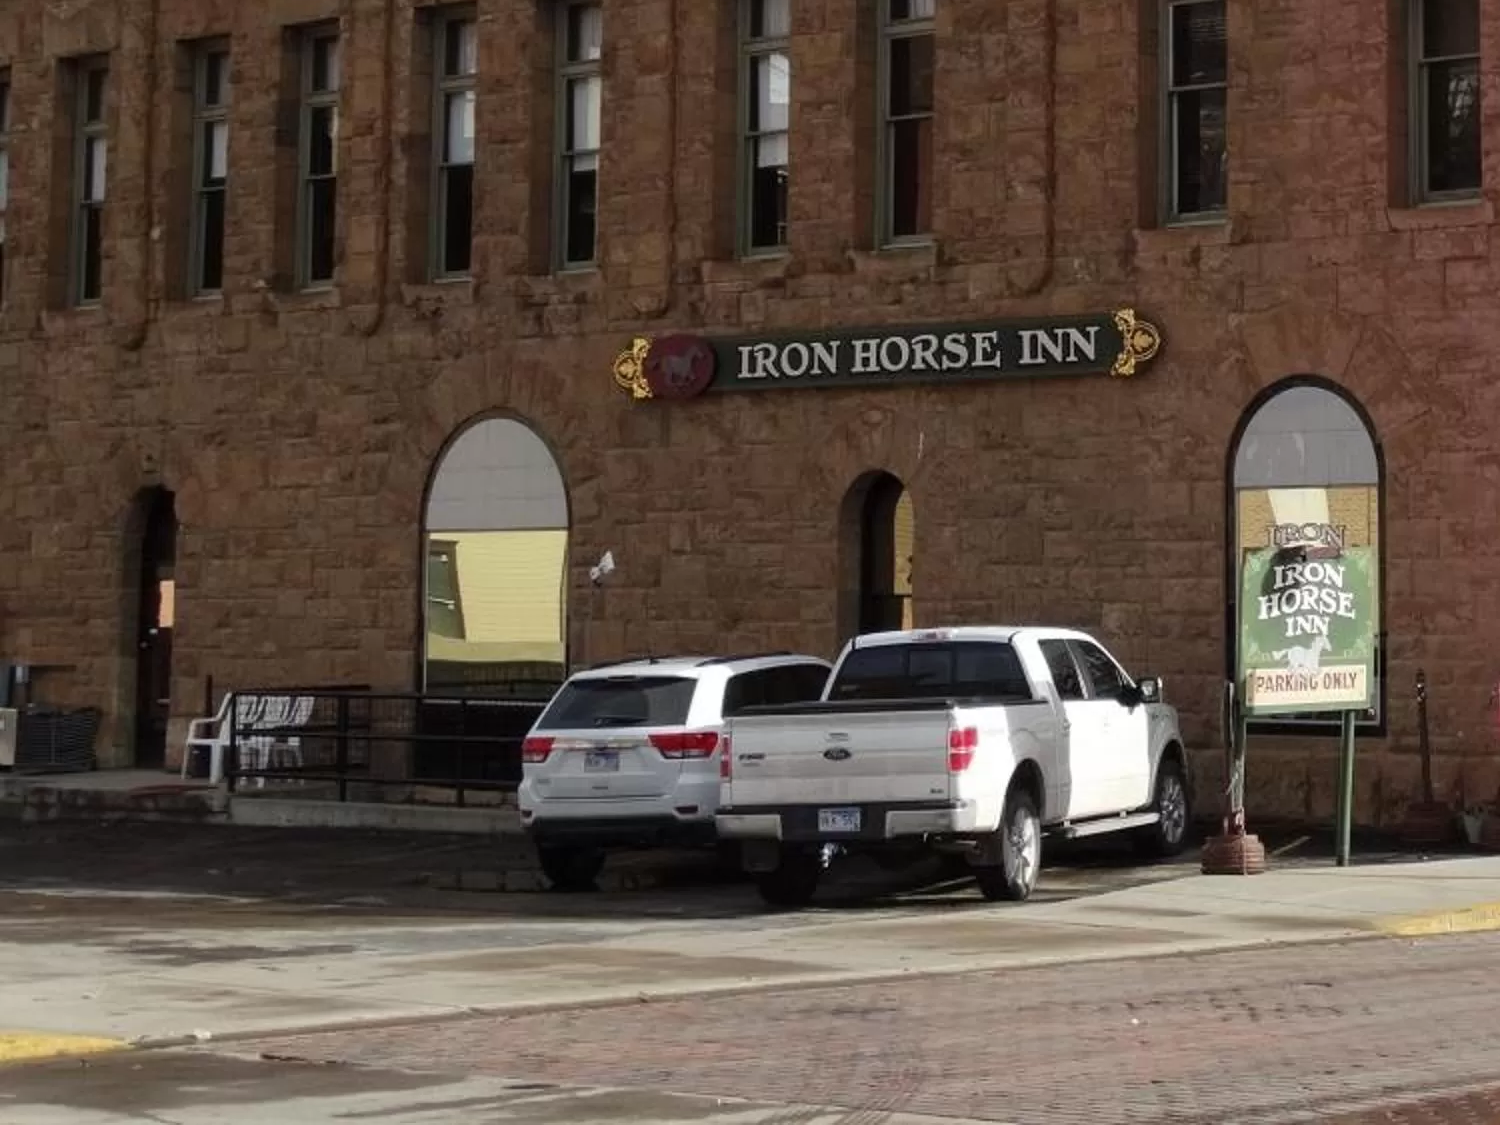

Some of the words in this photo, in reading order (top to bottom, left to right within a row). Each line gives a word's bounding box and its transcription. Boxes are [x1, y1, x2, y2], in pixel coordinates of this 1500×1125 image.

[737, 340, 841, 379] IRON
[850, 331, 1001, 373] HORSE
[1017, 326, 1099, 365] INN
[1266, 523, 1346, 555] IRON
[1273, 562, 1346, 589] IRON
[1257, 585, 1356, 619] HORSE
[1285, 615, 1330, 636] INN
[1255, 673, 1319, 692] PARKING
[1323, 672, 1357, 690] ONLY
